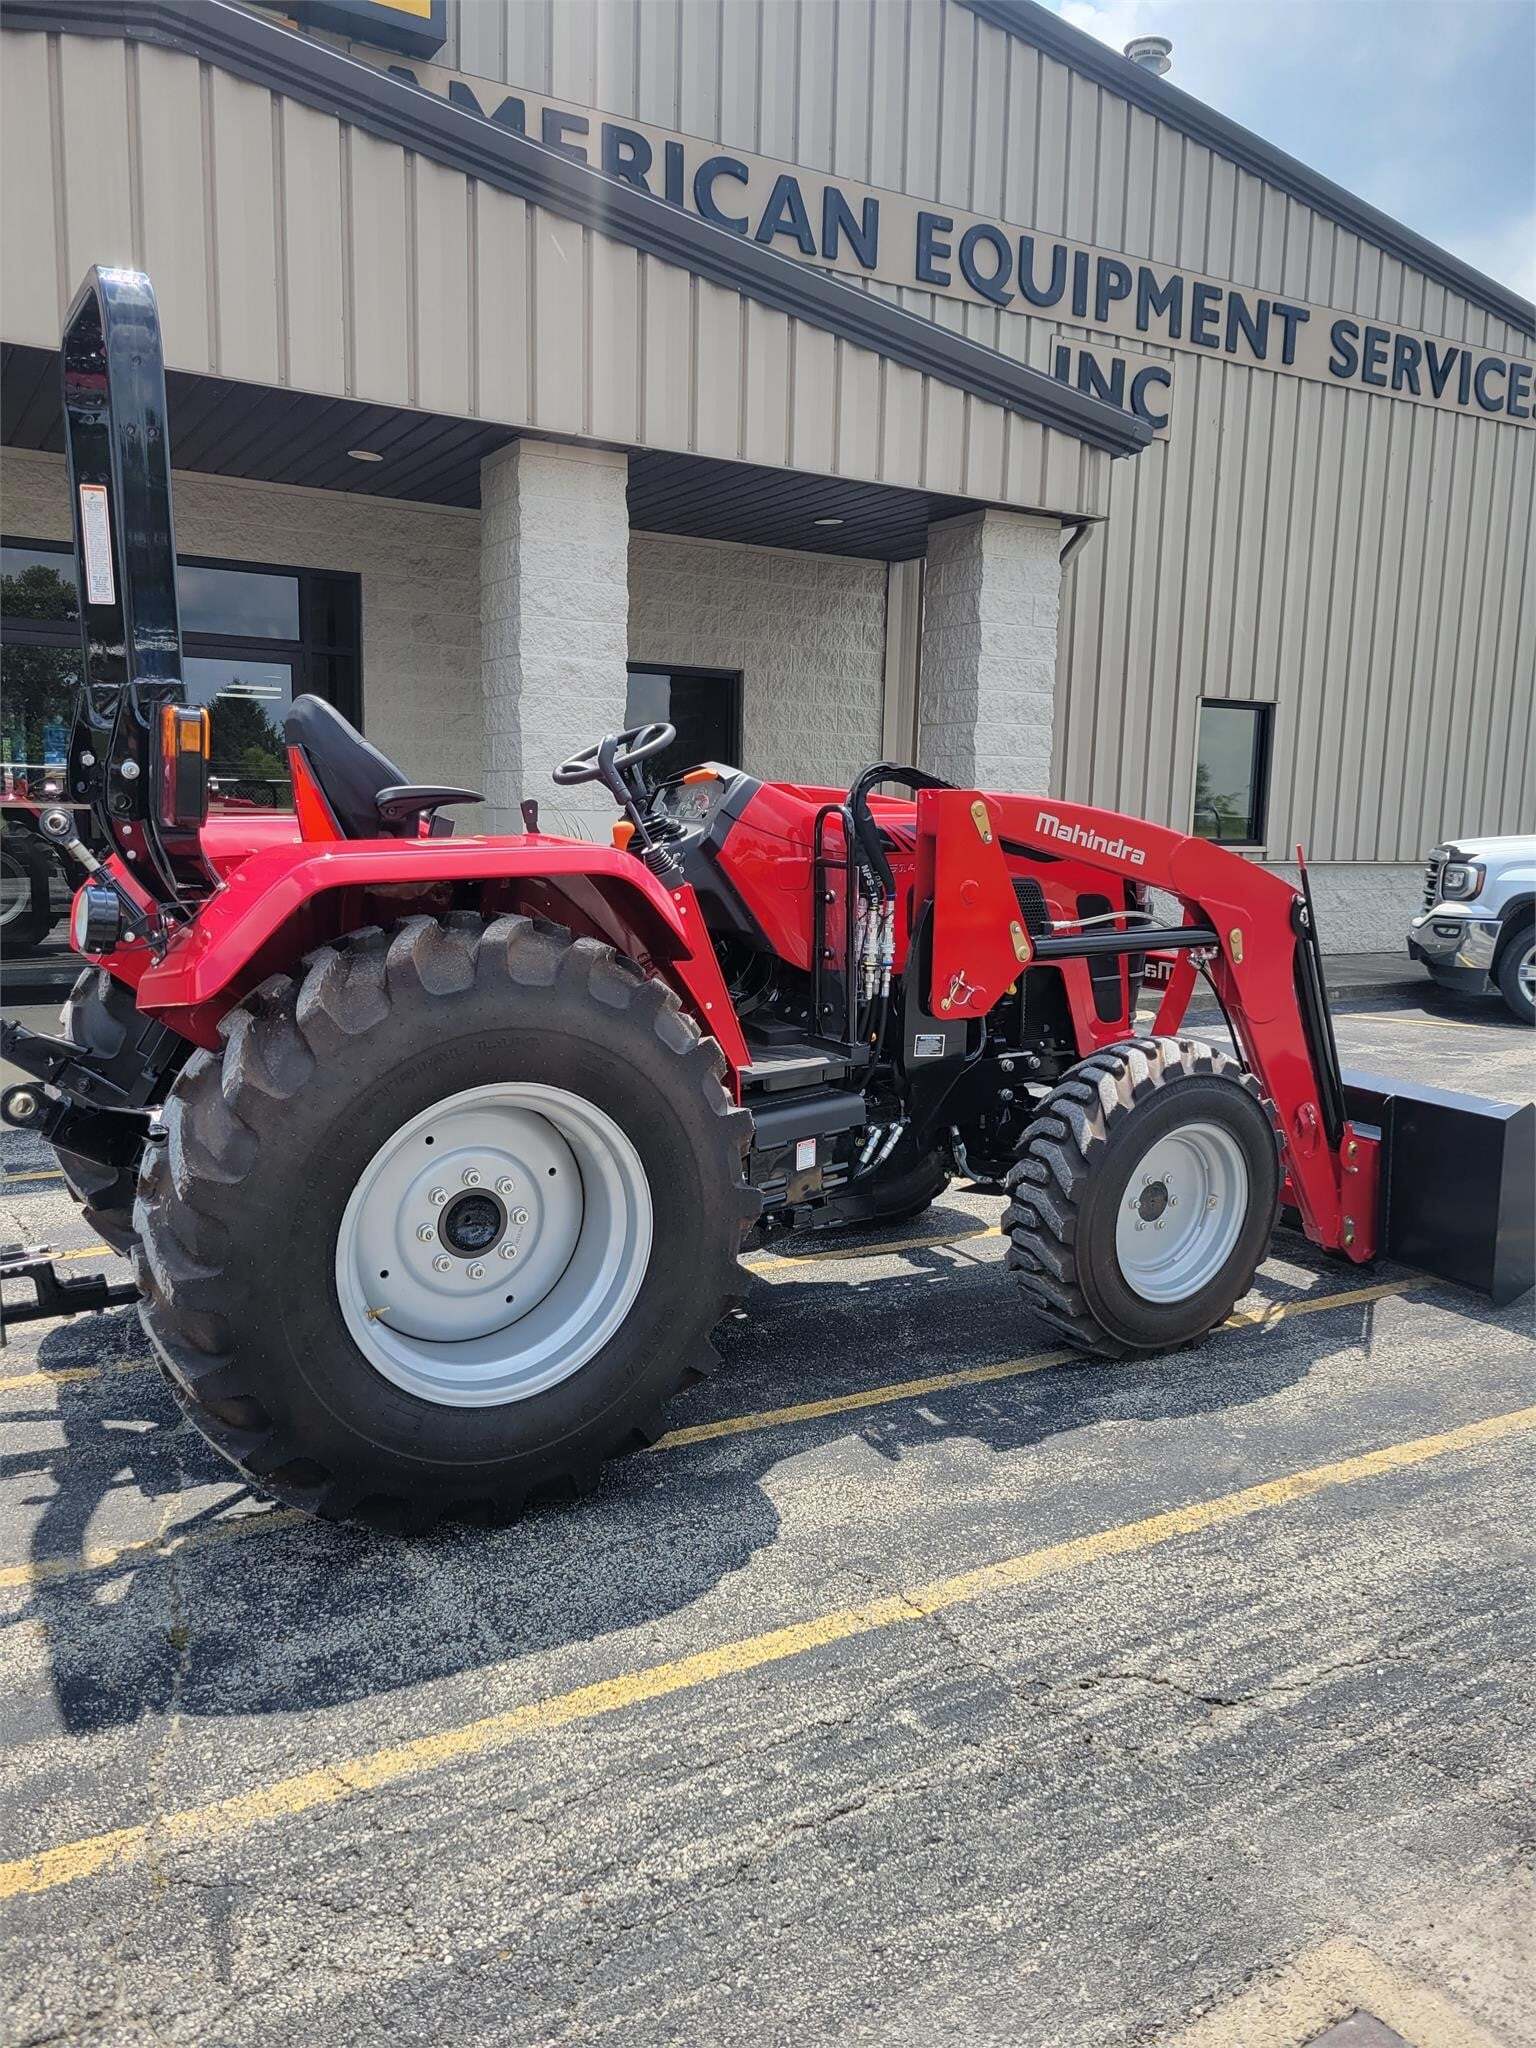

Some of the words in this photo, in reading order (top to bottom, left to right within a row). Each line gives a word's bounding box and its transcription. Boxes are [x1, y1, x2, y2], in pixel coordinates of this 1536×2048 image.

[916, 211, 1310, 364] EQUIPMENT
[1329, 319, 1536, 420] SERVICE
[1055, 345, 1172, 429] INC
[1035, 812, 1146, 865] Mahindra
